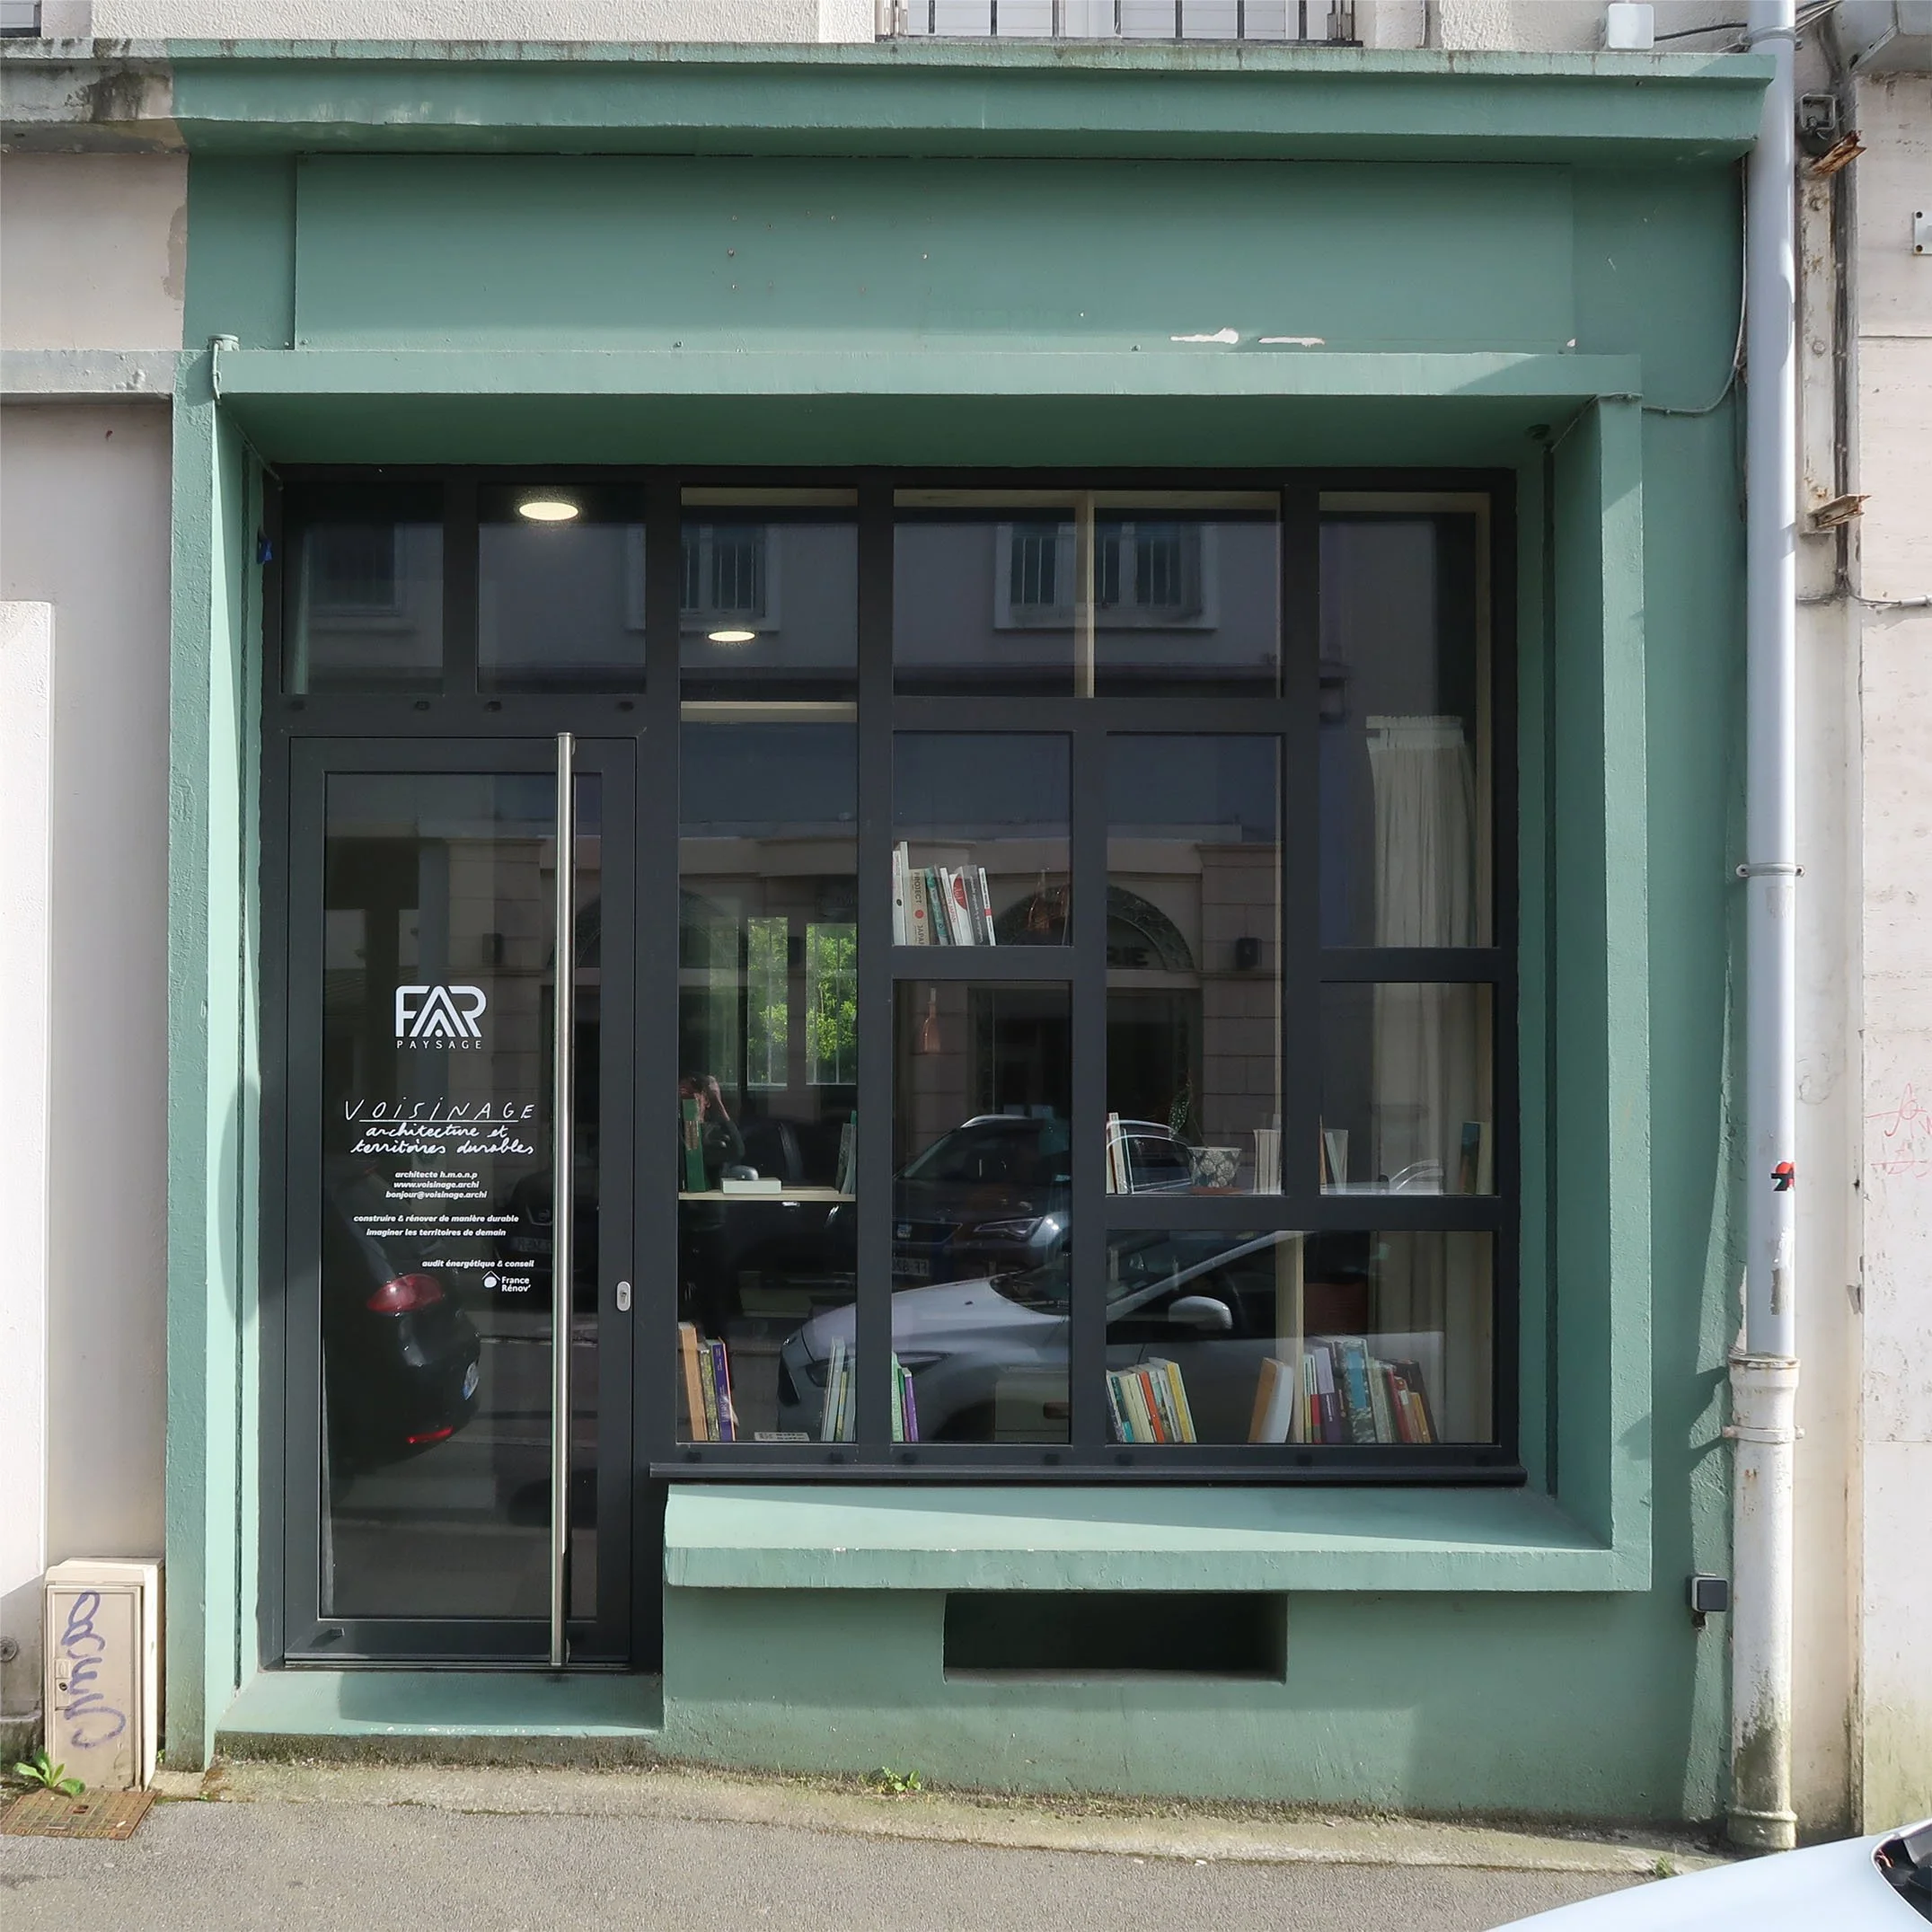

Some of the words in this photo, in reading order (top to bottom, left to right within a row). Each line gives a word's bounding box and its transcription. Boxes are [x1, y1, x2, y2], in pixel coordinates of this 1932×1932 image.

[913, 872, 922, 904] PROJECT
[395, 985, 487, 1037] FAR
[396, 1040, 482, 1049] PAYSAGE
[366, 1123, 480, 1138] architecture
[487, 1125, 509, 1138] et
[350, 1138, 446, 1154] territoires
[456, 1137, 534, 1155] durables
[395, 1170, 438, 1178] architecte
[440, 1170, 478, 1179] h.m.o.n.p
[393, 1181, 480, 1190] www.voisinage.archi
[385, 1191, 488, 1200] bonjour@voisinage.archi
[353, 1214, 396, 1222] construire
[398, 1214, 404, 1222] &
[405, 1214, 437, 1222] rénover
[439, 1214, 449, 1222] de
[451, 1214, 486, 1222] manière
[487, 1214, 519, 1222] durable
[366, 1229, 403, 1238] imaginer
[405, 1229, 418, 1237] les
[419, 1229, 461, 1237] territoires
[463, 1229, 473, 1237] de
[475, 1229, 507, 1237] demain
[422, 1259, 445, 1267] audit
[446, 1259, 495, 1269] énergétique
[497, 1259, 503, 1267] &
[505, 1259, 534, 1267] conseil
[501, 1276, 530, 1284] France
